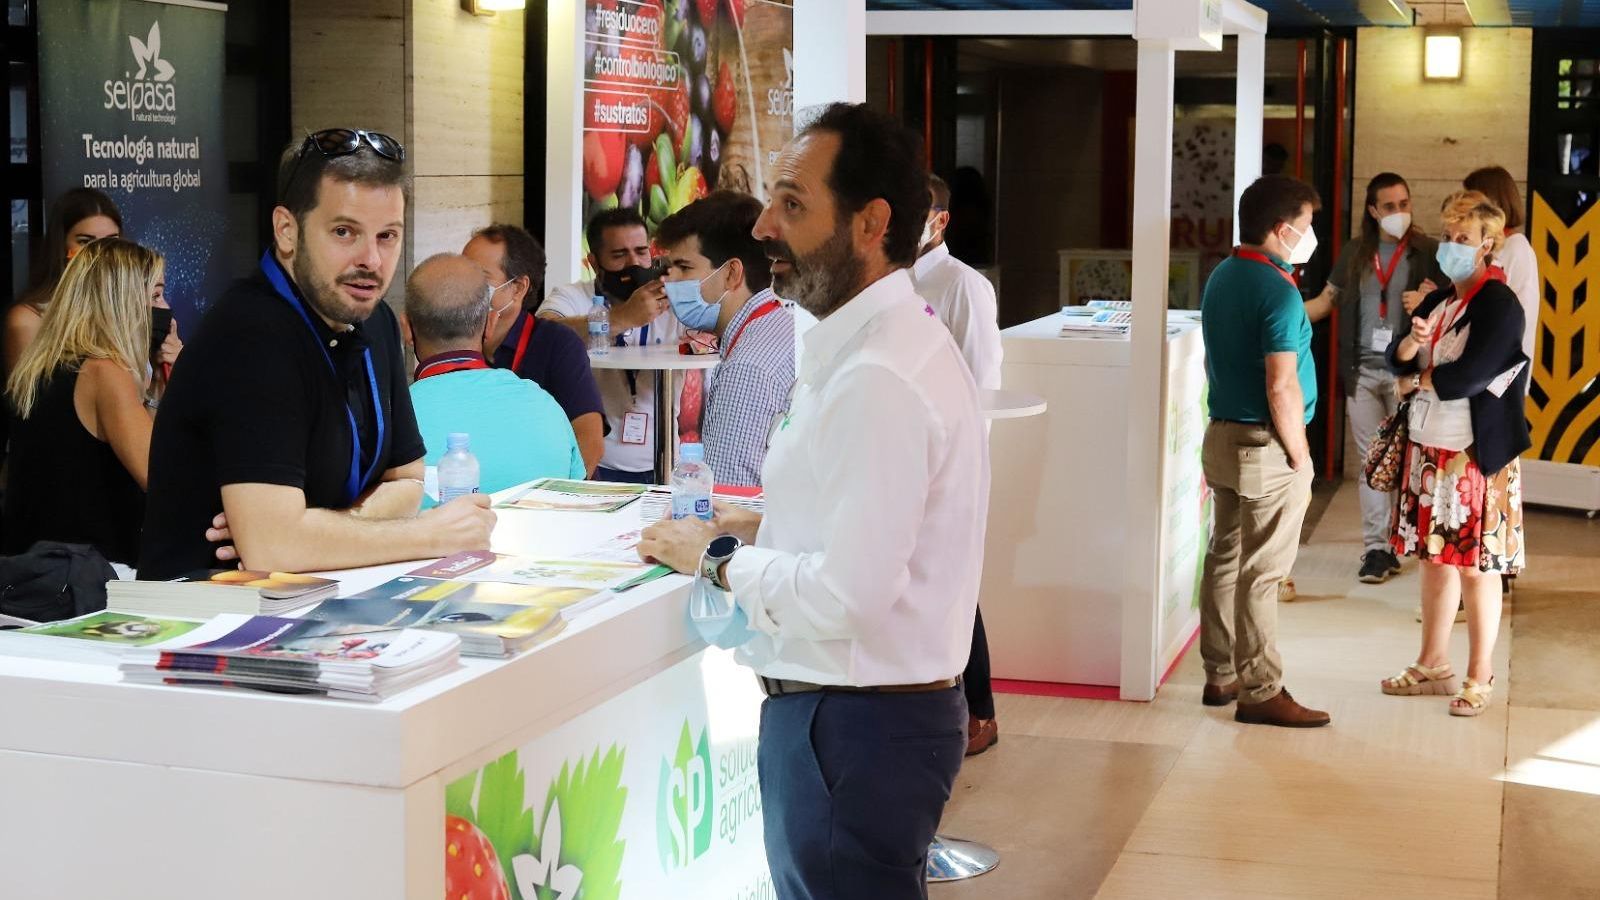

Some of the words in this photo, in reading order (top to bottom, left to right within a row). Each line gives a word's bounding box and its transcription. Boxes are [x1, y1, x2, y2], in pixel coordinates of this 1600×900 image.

[595, 3, 658, 35] #residuocero
[104, 71, 176, 121] seipasa
[594, 99, 648, 125] #sustratos
[82, 134, 154, 165] Tecnología
[157, 136, 200, 159] natural
[84, 174, 107, 189] para
[109, 168, 118, 188] la
[120, 169, 172, 193] agricultura
[173, 168, 200, 192] global
[1171, 216, 1233, 248] RU
[719, 735, 758, 789] soluc
[719, 776, 763, 844] agríco
